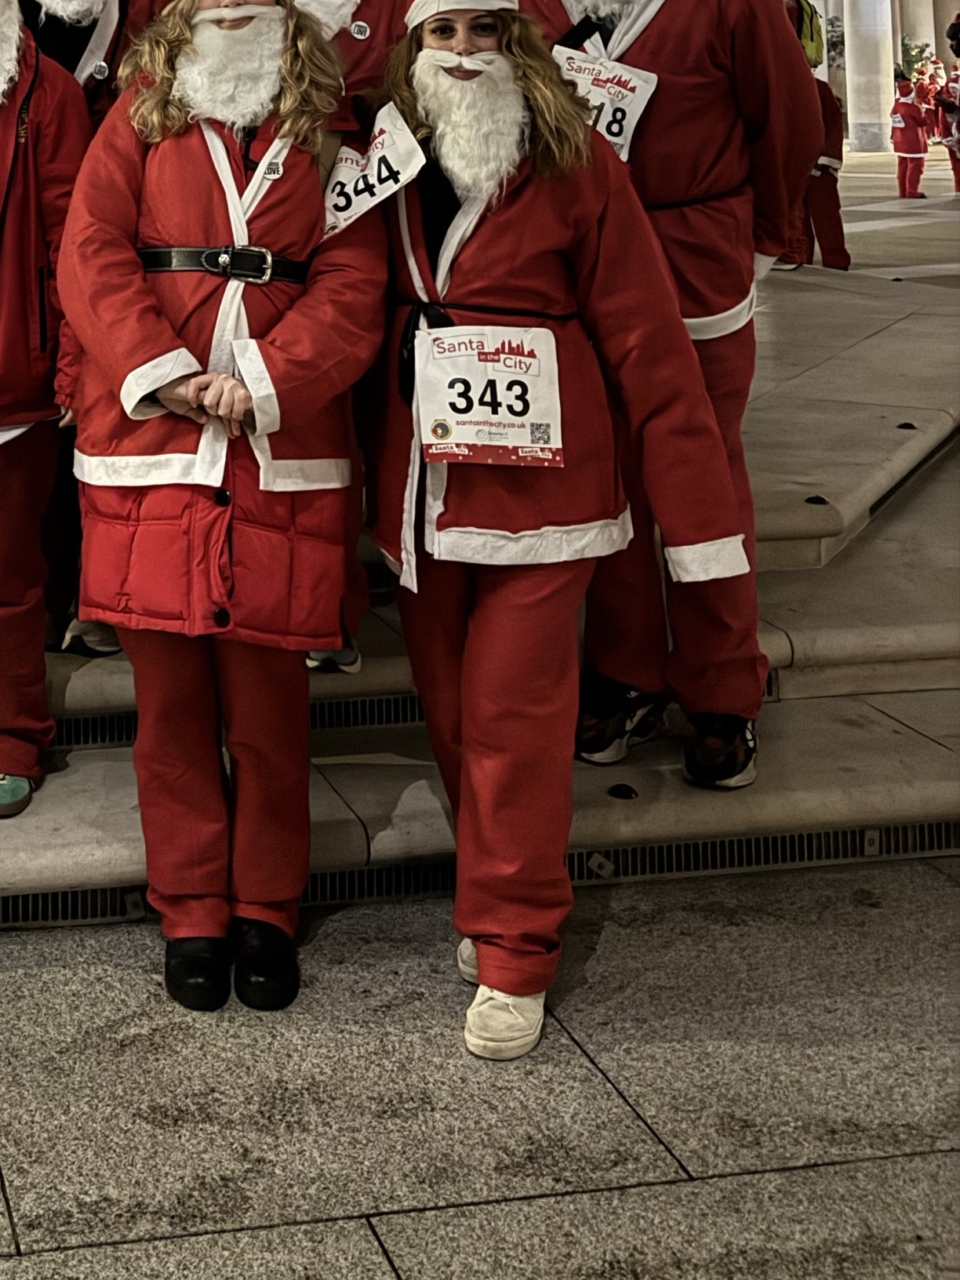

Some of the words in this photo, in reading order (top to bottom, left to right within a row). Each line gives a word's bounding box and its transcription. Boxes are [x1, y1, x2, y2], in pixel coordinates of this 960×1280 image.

[566, 61, 602, 77] Santa
[607, 86, 628, 102] City
[331, 154, 401, 213] 344
[436, 338, 485, 354] Santa
[503, 356, 532, 373] City
[447, 377, 530, 417] 343
[455, 419, 527, 430] santainthecity.co.uk
